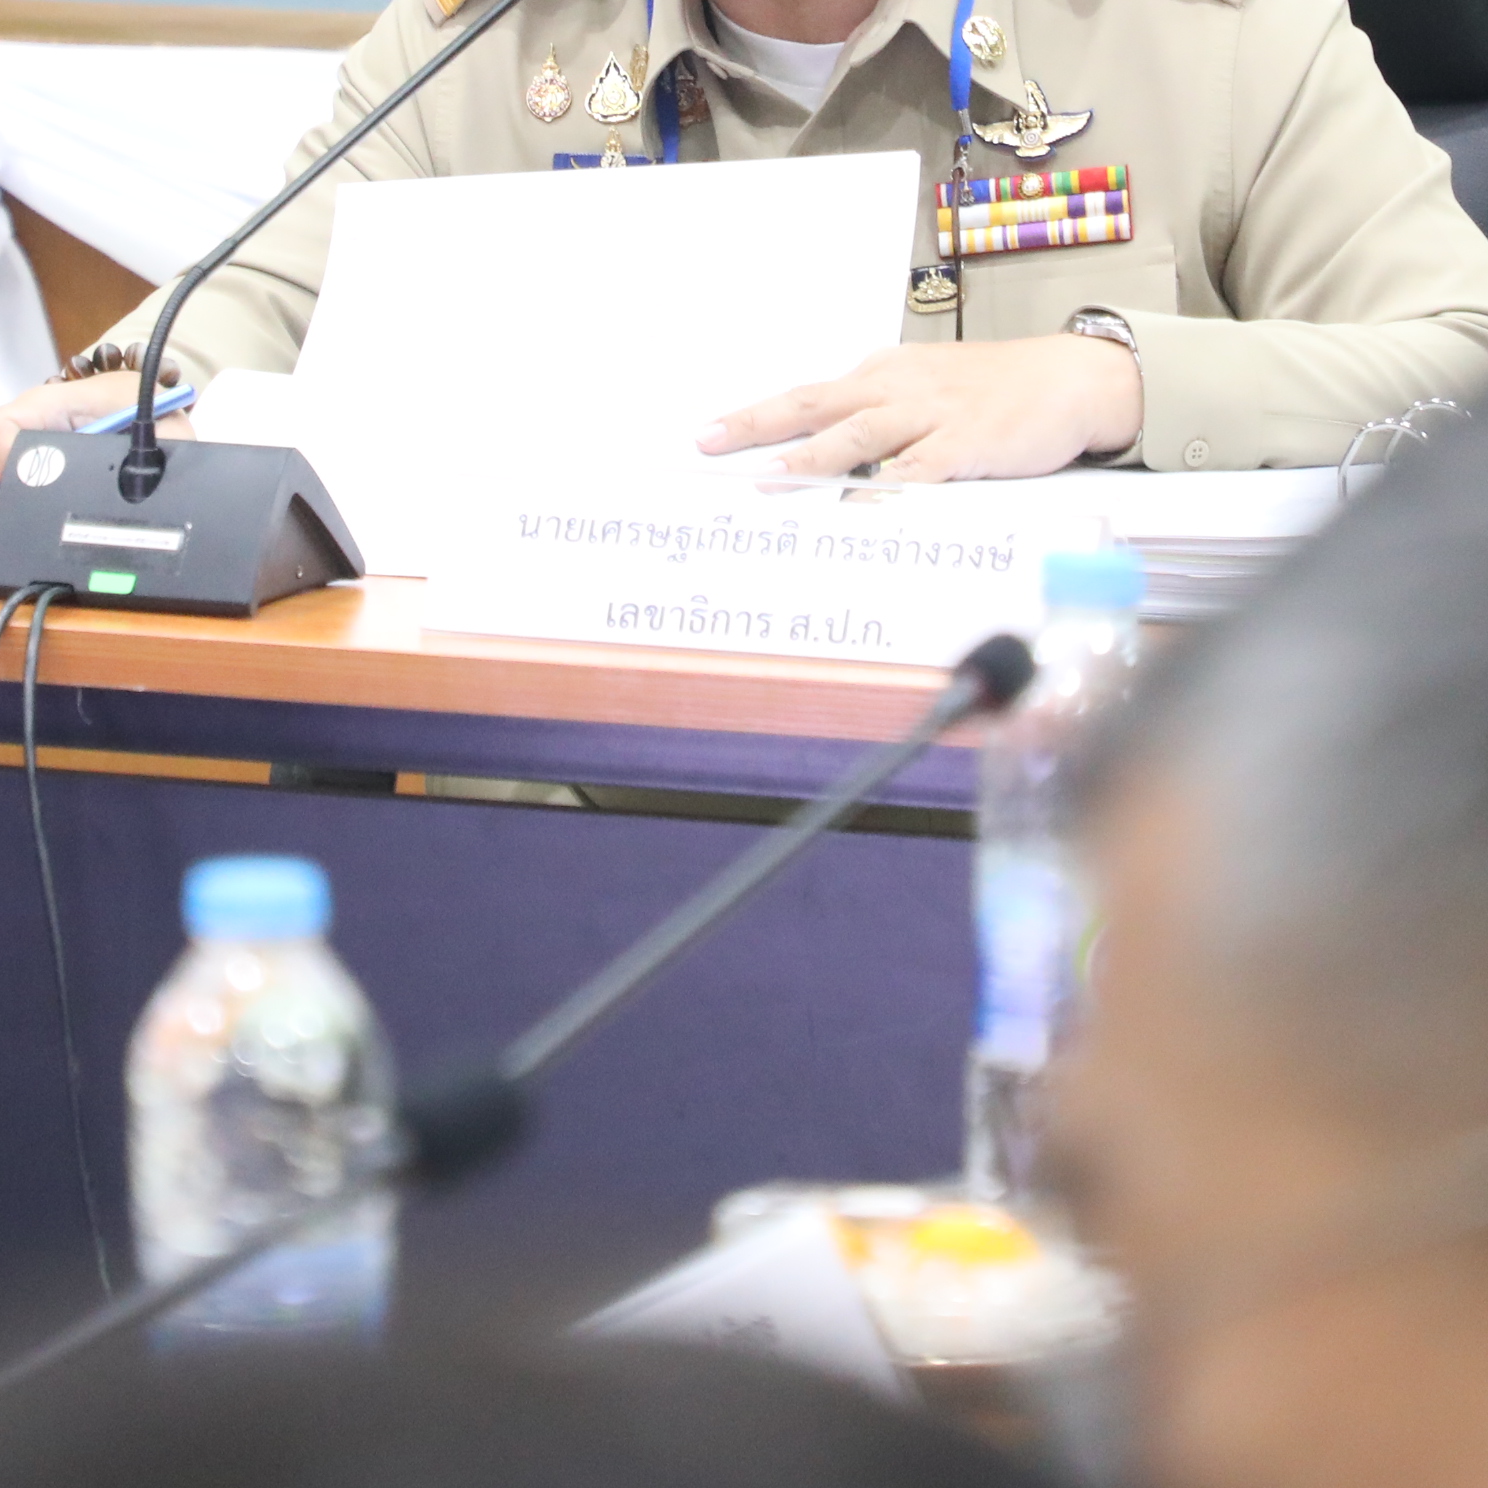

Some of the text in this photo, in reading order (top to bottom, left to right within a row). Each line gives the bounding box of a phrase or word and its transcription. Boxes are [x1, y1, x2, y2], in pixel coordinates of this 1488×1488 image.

[518, 510, 1016, 574] นายเศรษฐเกียรติ กระจ่างวงษ์
[605, 594, 893, 648] เลขาธิการ ส.ป.ก.
